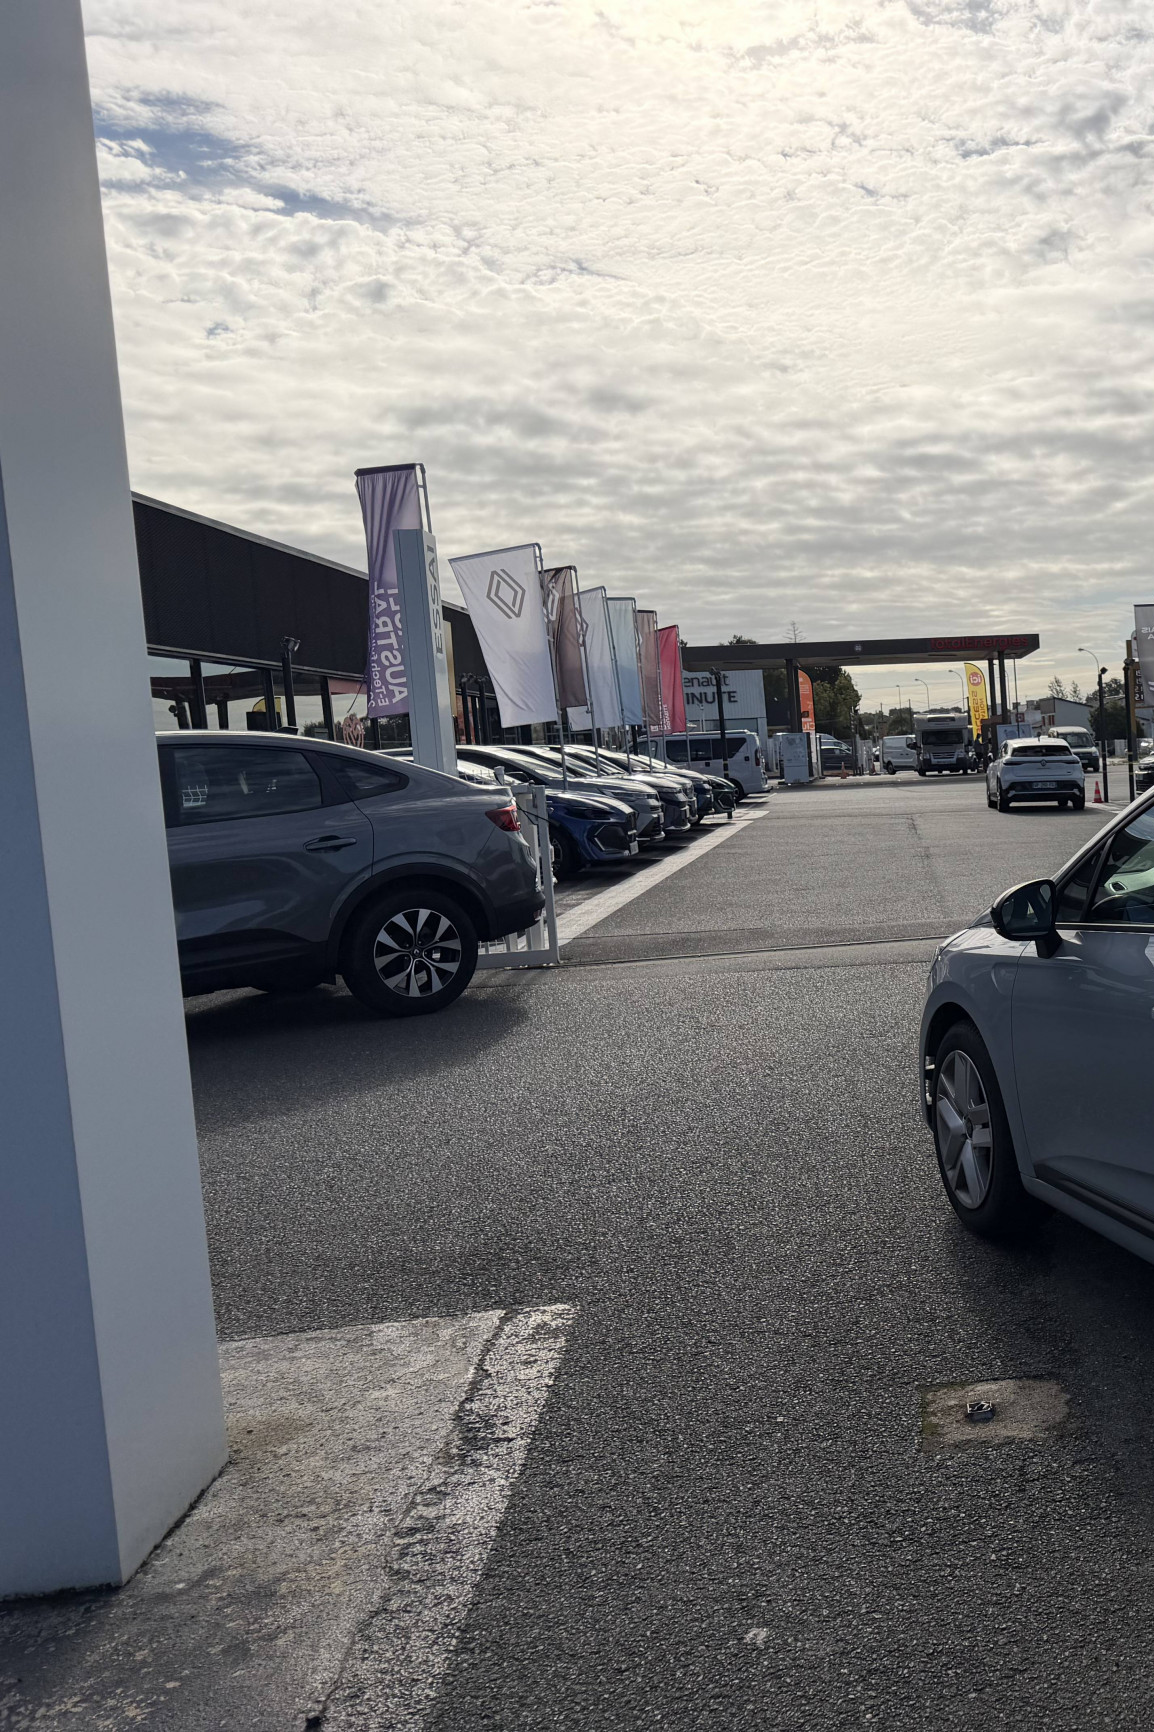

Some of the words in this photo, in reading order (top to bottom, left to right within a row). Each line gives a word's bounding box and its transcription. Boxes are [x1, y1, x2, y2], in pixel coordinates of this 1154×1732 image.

[427, 545, 443, 655] ESSAI
[930, 637, 1029, 651] TotalEnergies
[684, 674, 730, 688] enaut
[685, 690, 738, 705] INUE
